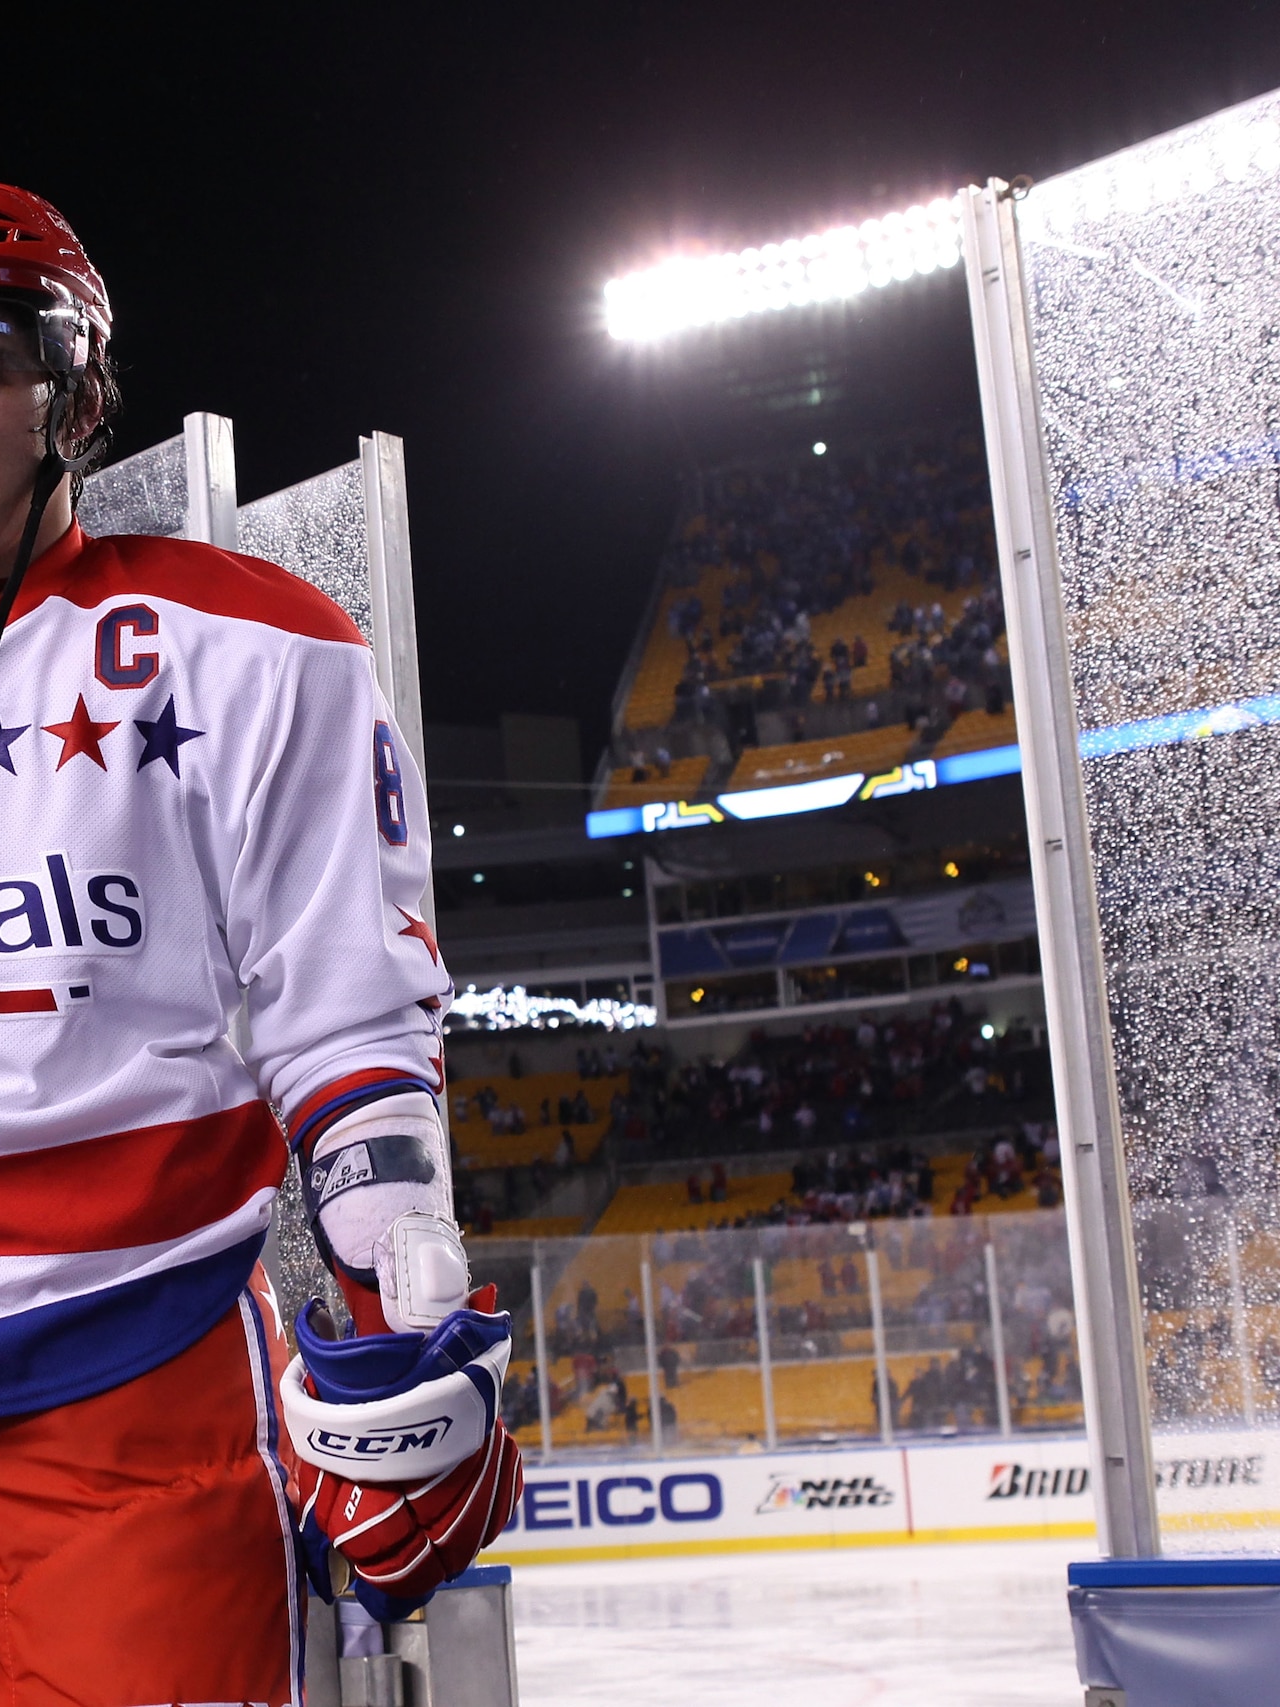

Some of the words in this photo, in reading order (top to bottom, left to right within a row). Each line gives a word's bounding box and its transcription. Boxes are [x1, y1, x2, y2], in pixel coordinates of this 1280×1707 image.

[95, 603, 159, 690] C
[373, 719, 408, 846] 8
[317, 1427, 439, 1454] CCM
[503, 1473, 724, 1534] EICO
[801, 1476, 885, 1494] NHL
[806, 1491, 895, 1511] NBC
